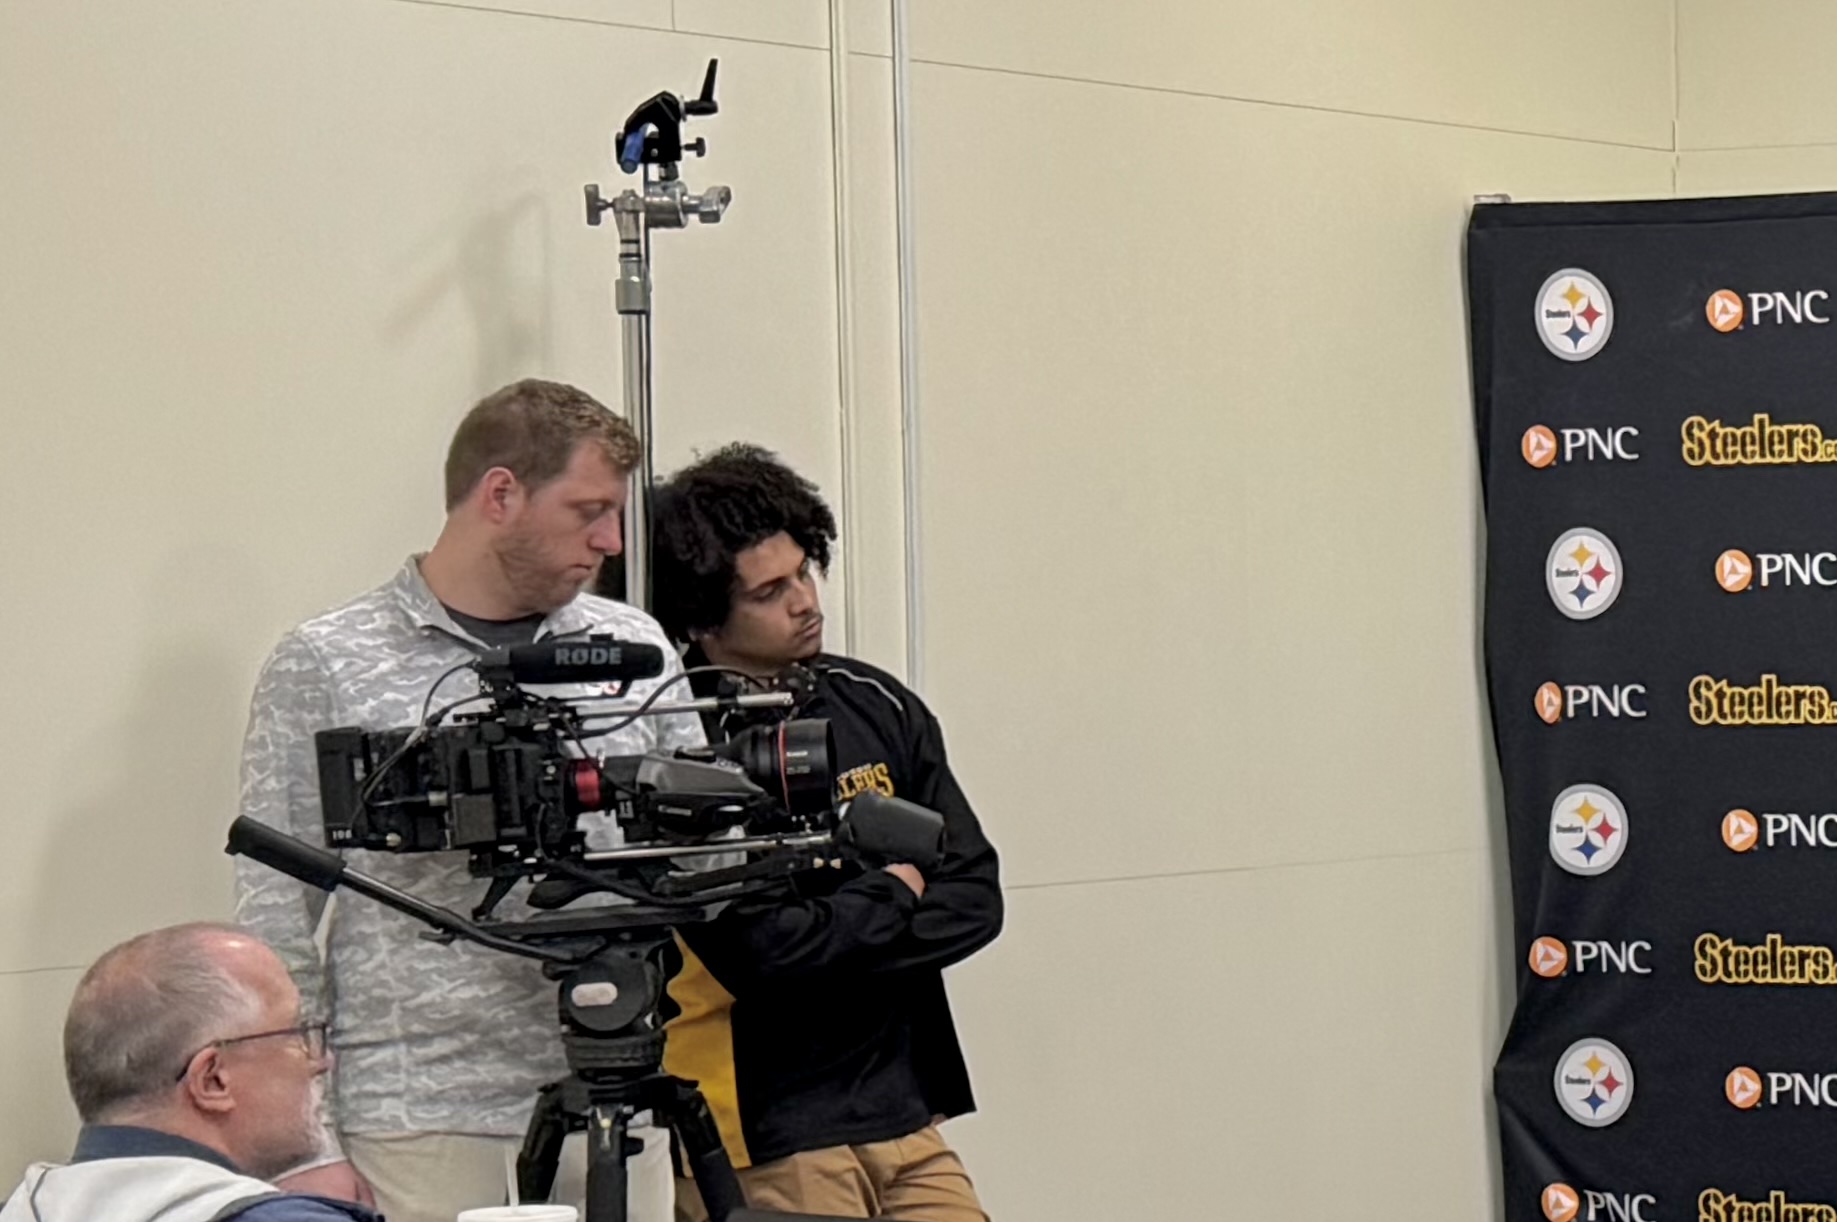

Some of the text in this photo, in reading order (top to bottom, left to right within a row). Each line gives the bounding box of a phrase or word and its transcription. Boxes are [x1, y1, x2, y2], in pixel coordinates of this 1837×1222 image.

[1749, 290, 1829, 325] PNC
[1562, 427, 1638, 461] PNC
[1758, 552, 1837, 586] PNC
[1566, 685, 1646, 717] PNC
[1574, 941, 1651, 973] PNC
